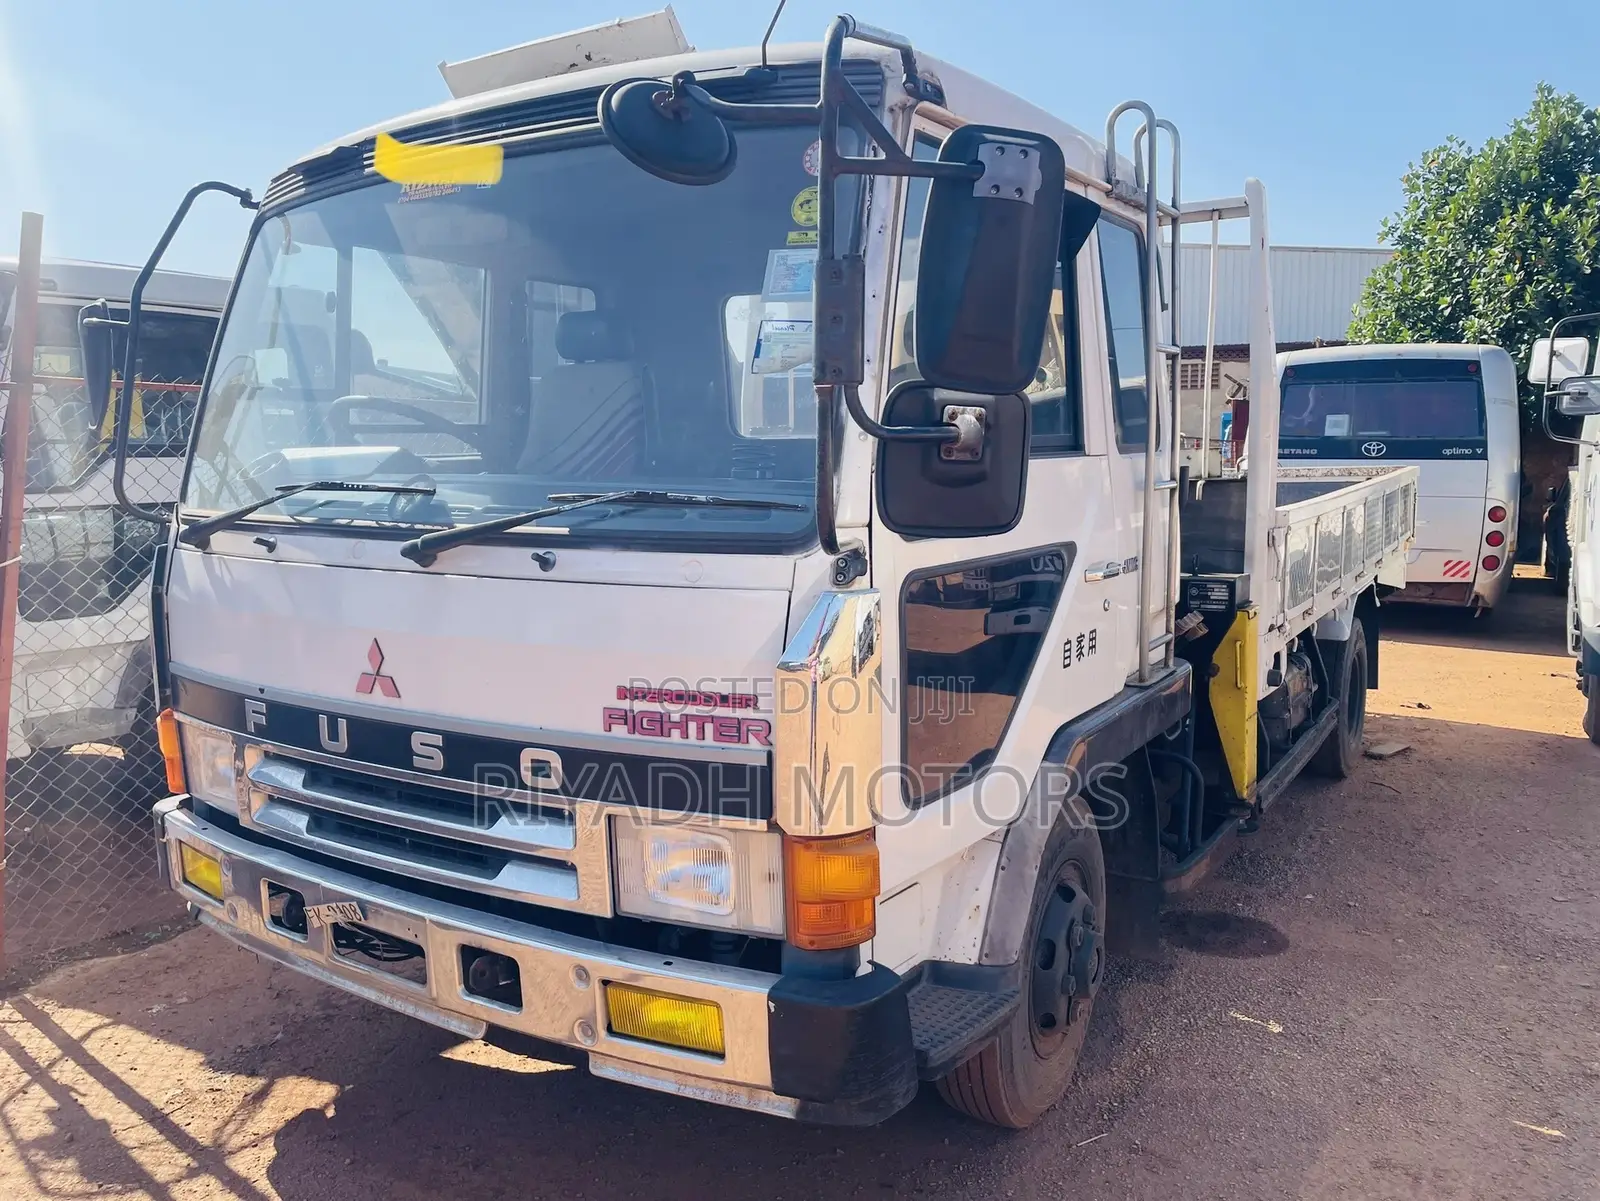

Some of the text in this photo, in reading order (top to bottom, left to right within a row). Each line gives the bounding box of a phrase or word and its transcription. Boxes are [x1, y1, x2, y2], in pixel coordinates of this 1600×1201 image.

[1442, 447, 1473, 456] optimo
[1062, 628, 1097, 669] 自家用
[244, 698, 564, 790] FUSO
[603, 707, 773, 746] FIGHTER
